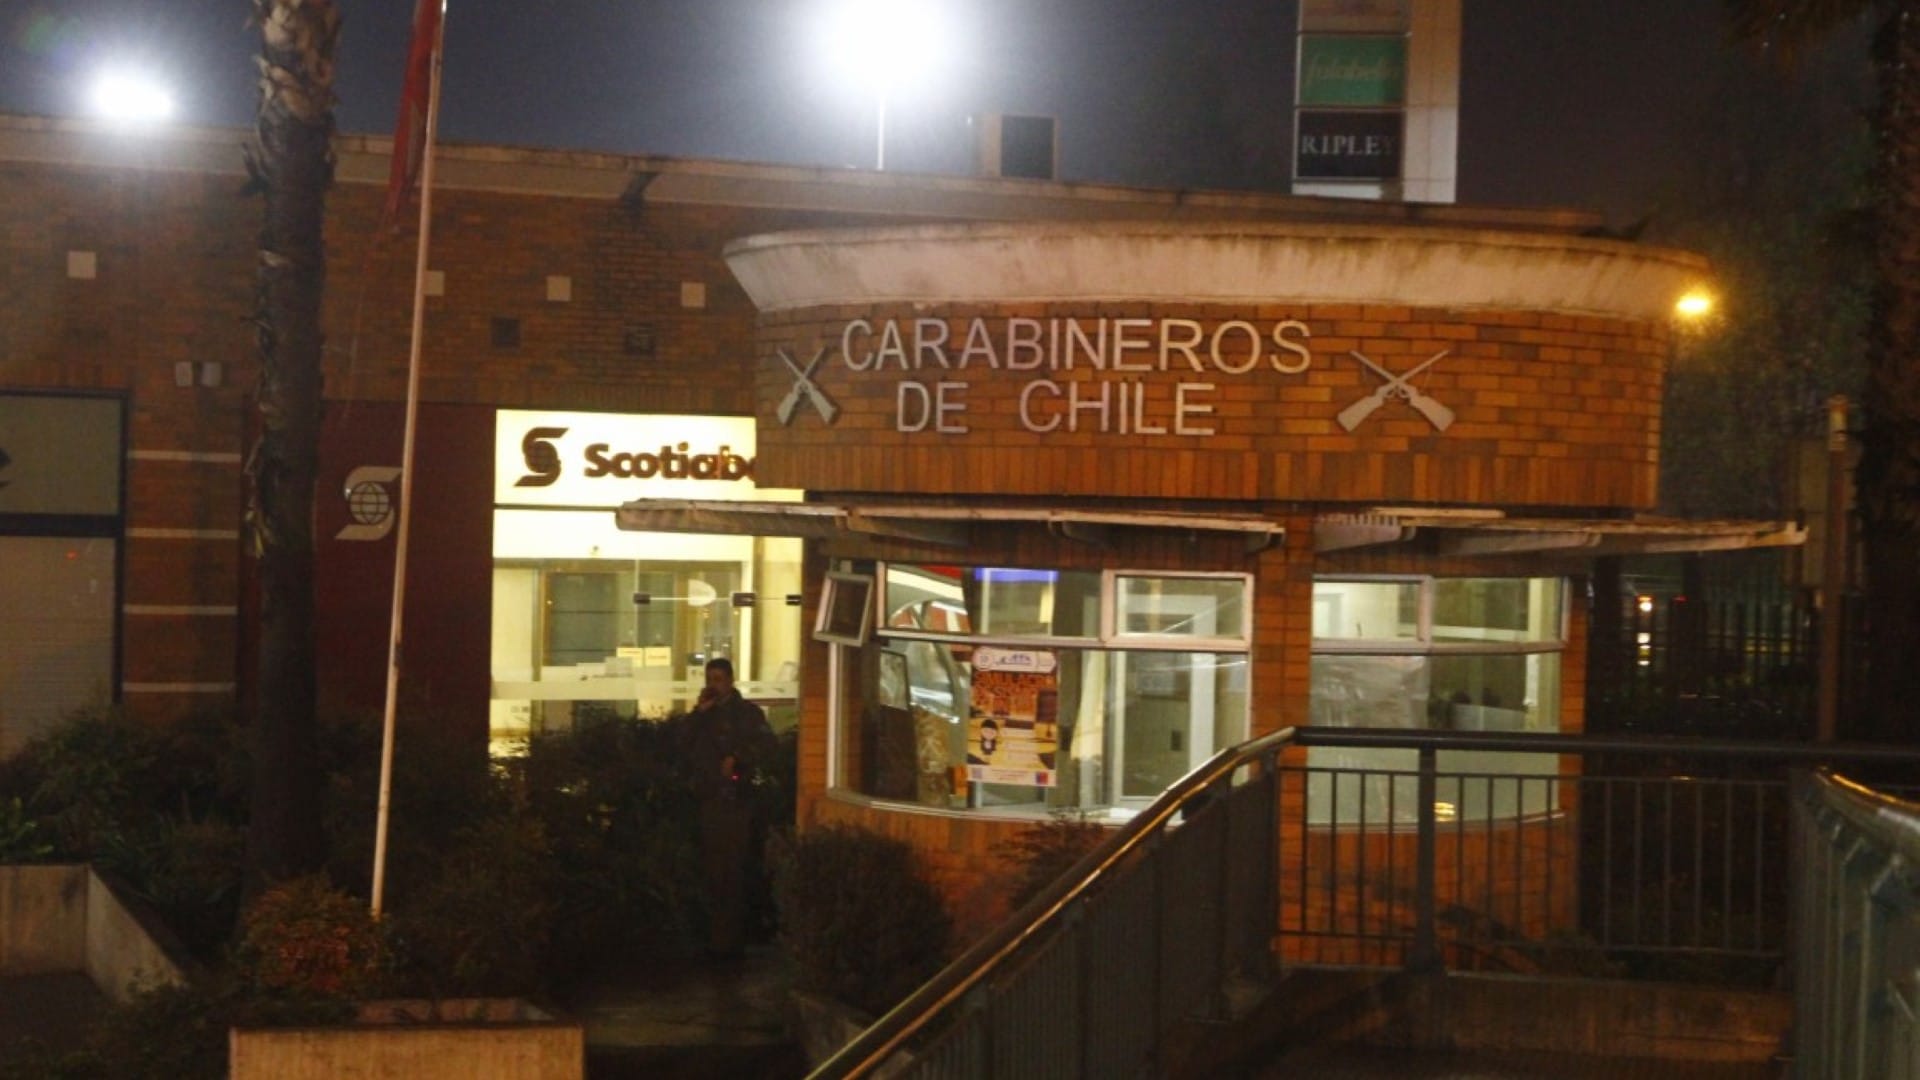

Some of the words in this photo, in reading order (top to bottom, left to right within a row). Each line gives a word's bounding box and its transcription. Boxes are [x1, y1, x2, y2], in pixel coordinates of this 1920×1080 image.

[842, 317, 1311, 374] CARABINEROS
[896, 380, 969, 434] DE
[1019, 378, 1216, 436] CHILE
[584, 441, 756, 481] Scotiab
